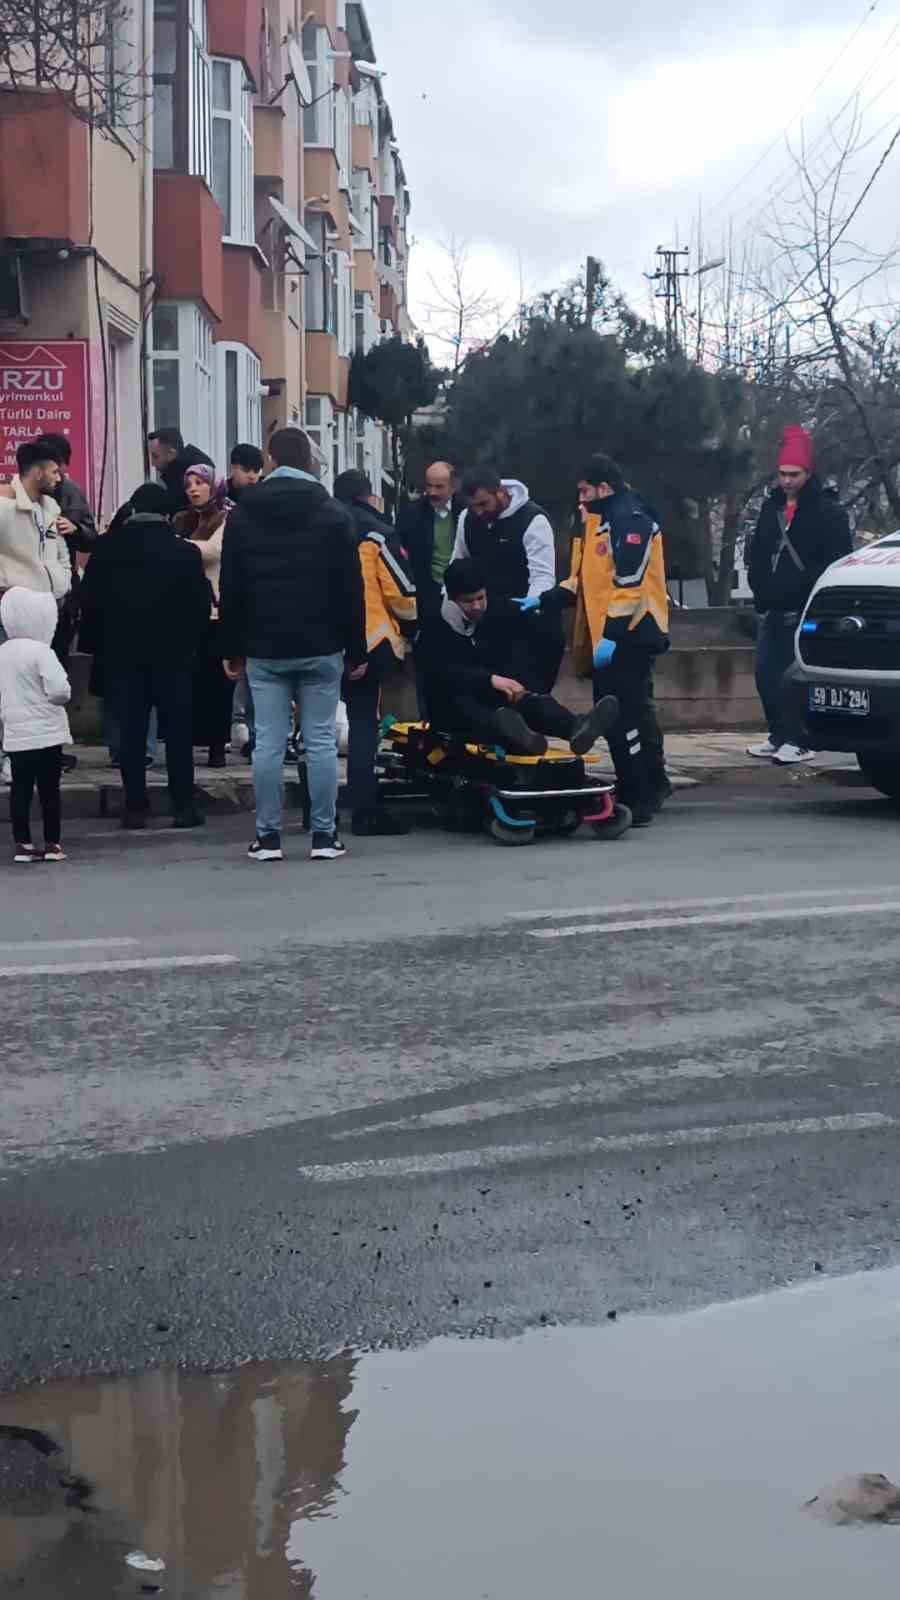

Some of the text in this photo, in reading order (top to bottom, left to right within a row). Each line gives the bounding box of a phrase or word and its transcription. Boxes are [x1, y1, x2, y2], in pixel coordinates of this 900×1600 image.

[0, 370, 64, 390] RZU
[37, 407, 71, 420] Daire
[3, 426, 43, 436] TARLA
[815, 687, 825, 704] 59
